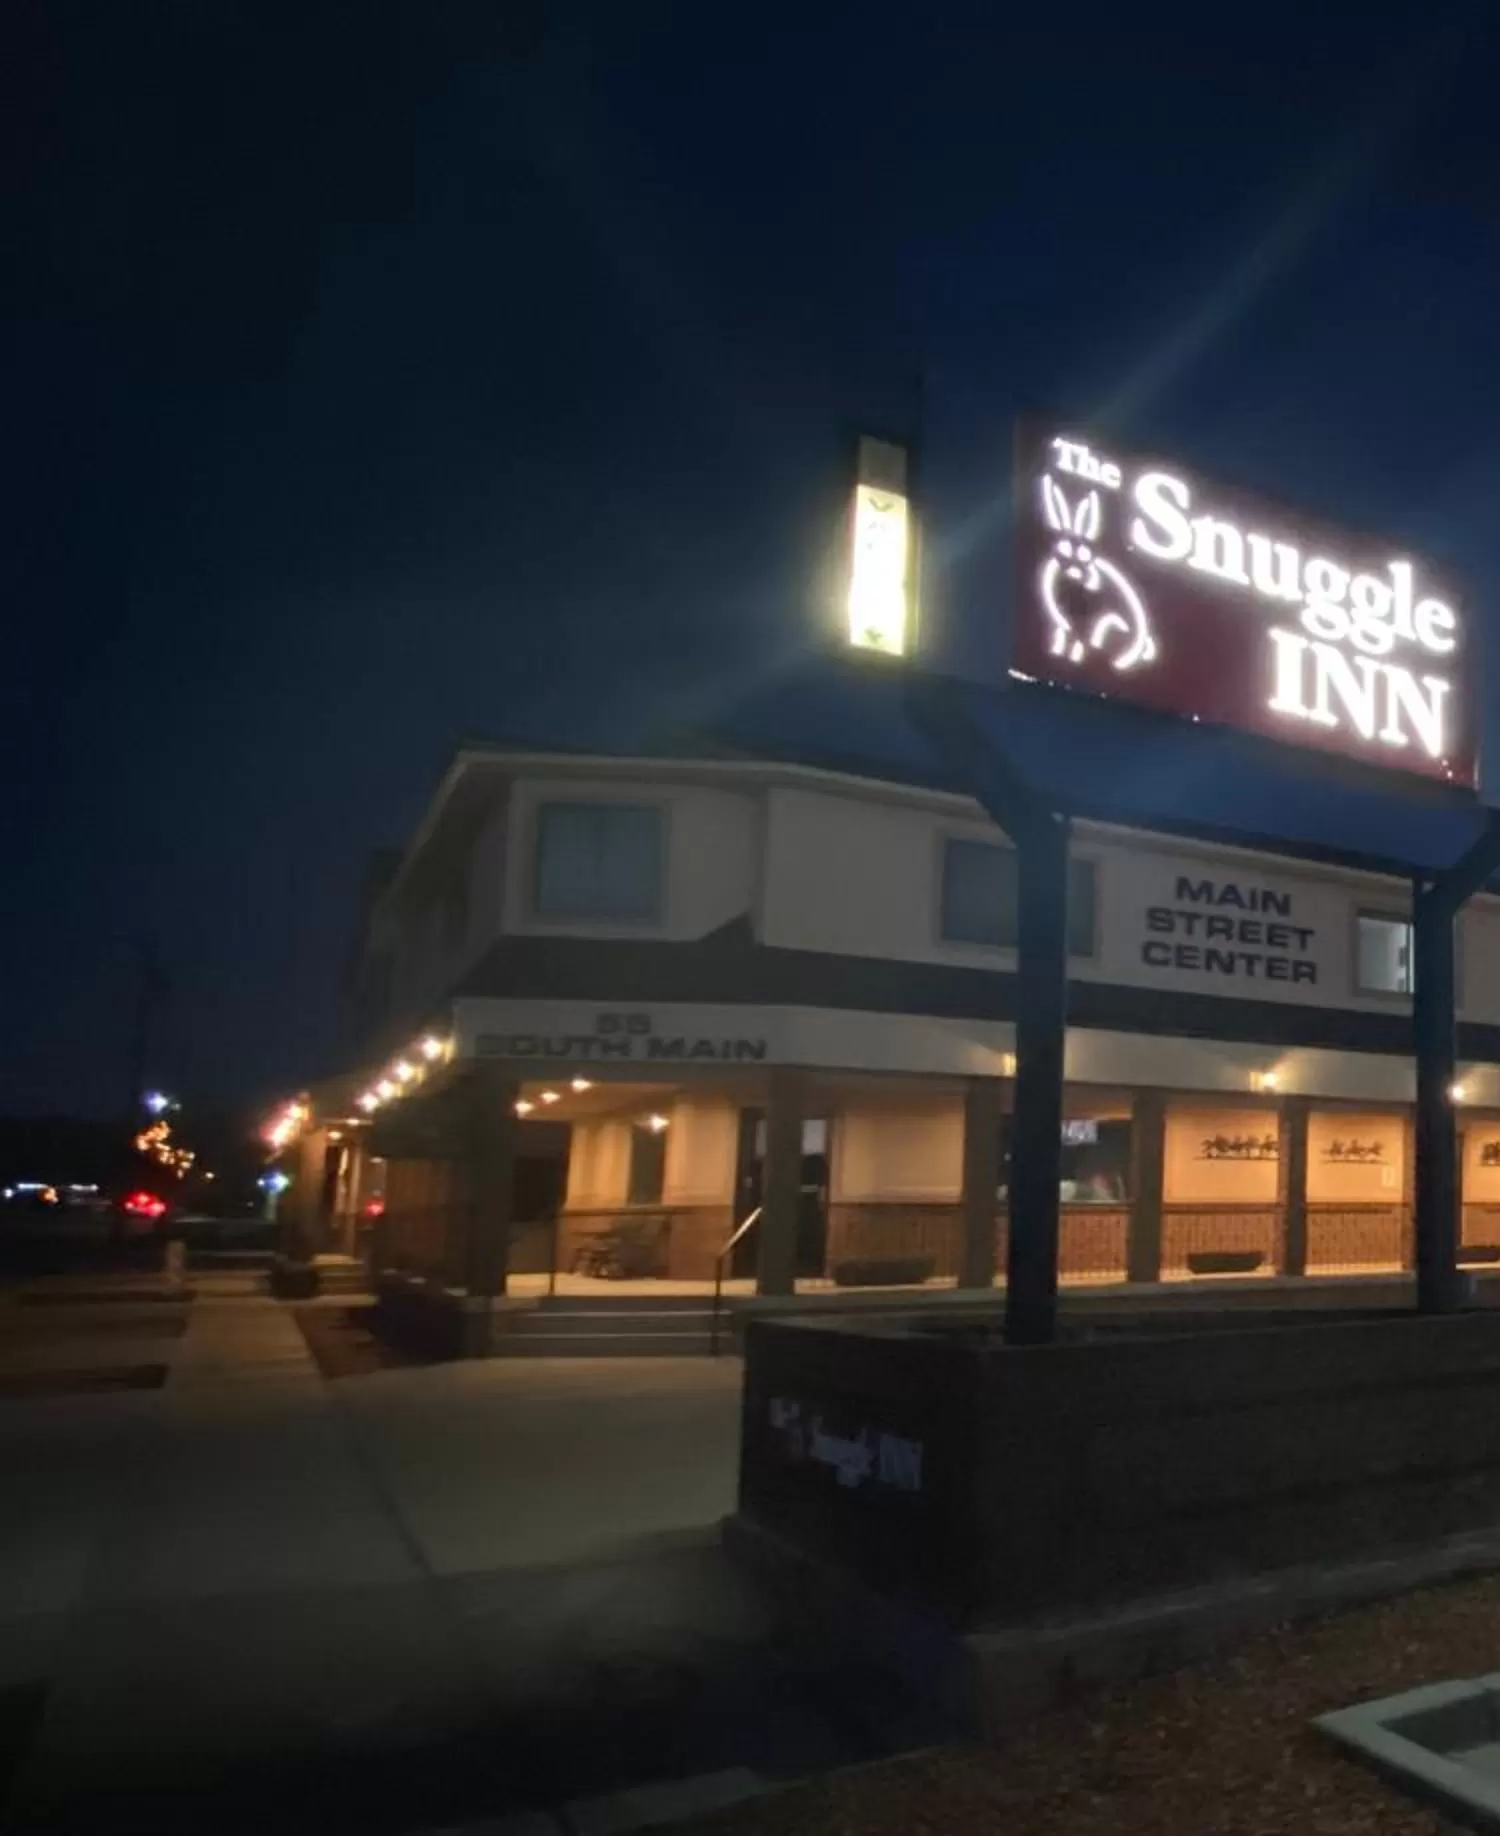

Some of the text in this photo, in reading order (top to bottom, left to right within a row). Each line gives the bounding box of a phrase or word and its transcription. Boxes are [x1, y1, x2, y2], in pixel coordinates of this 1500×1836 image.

[1052, 437, 1121, 488] The
[1131, 471, 1456, 655] Snuggle
[1267, 626, 1451, 758] INN
[1176, 876, 1292, 917] MAIN
[1147, 907, 1315, 951] STREET
[1142, 941, 1317, 985] CENTER
[647, 1036, 769, 1061] MAIN
